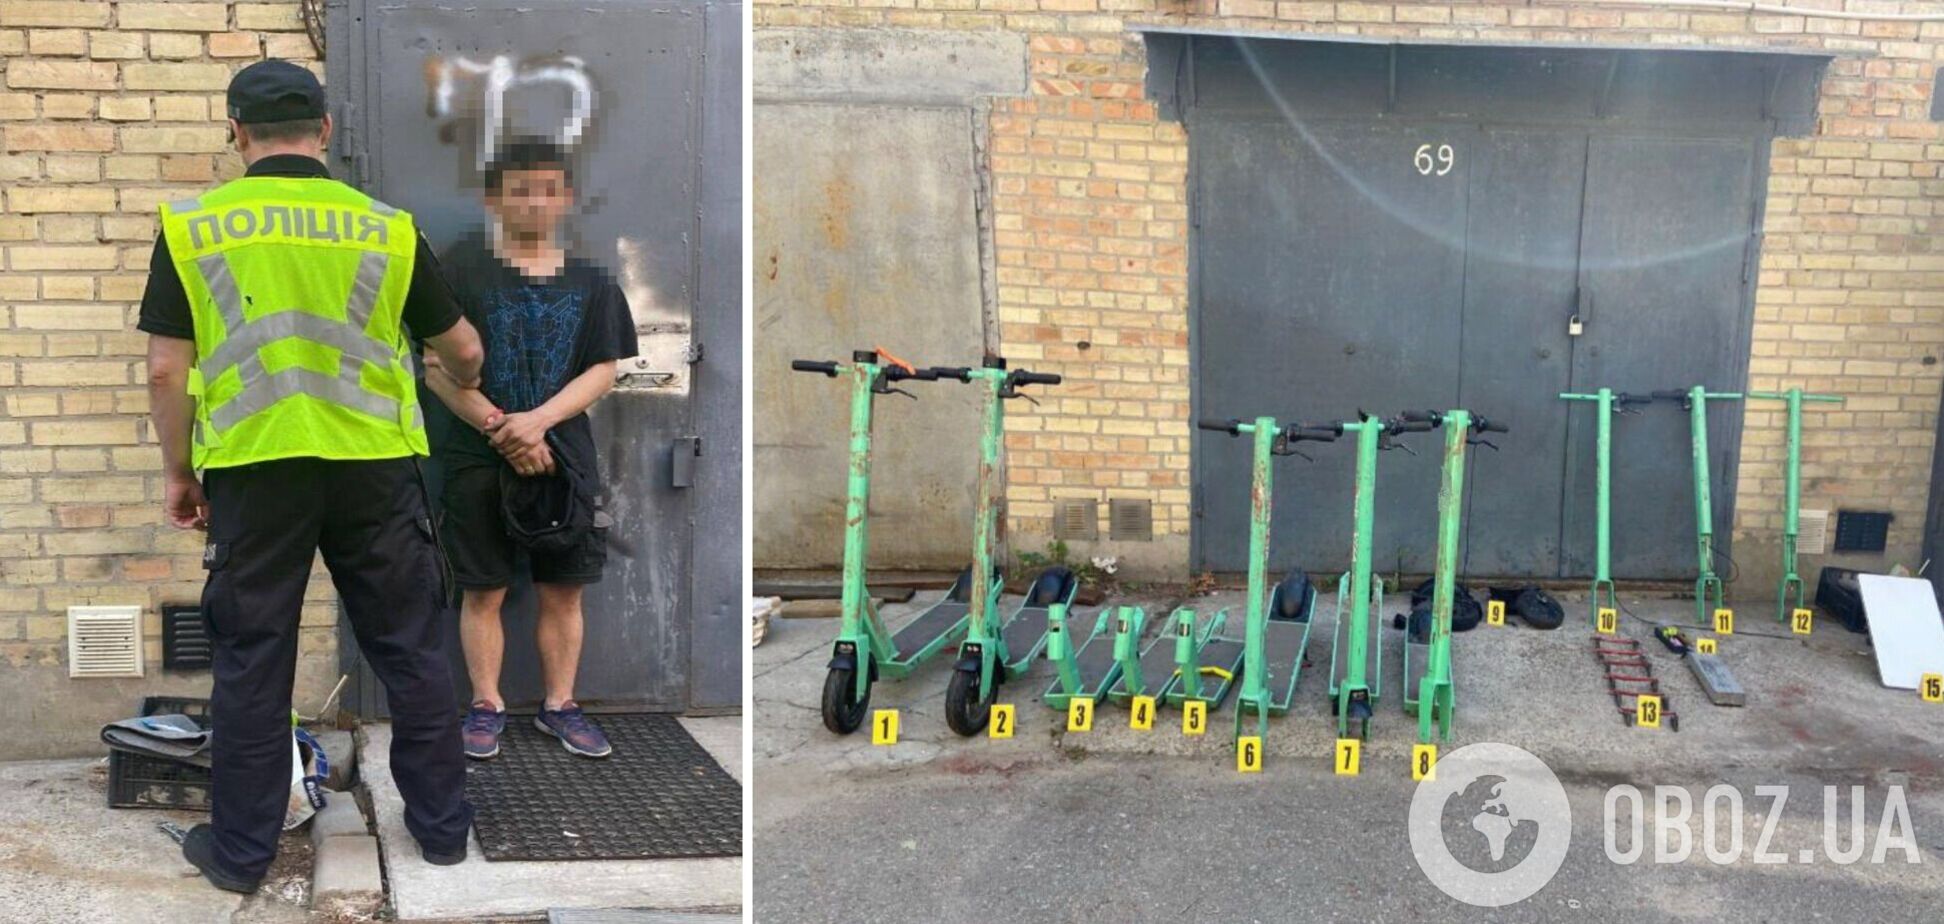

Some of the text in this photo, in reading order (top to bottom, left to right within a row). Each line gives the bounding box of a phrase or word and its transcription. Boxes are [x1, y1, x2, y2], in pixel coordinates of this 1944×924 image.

[1414, 144, 1454, 176] 69
[187, 205, 389, 250] ПОЛІЦІЯ
[1492, 605, 1500, 622] 9
[1601, 612, 1614, 630] 10
[1718, 613, 1729, 631] 11
[1796, 613, 1809, 630] 12
[1926, 678, 1940, 698] 15
[996, 710, 1007, 733] 2
[1075, 704, 1085, 727] 3
[1136, 703, 1147, 725] 4
[1189, 707, 1199, 729] 5
[1641, 700, 1657, 723] 13
[881, 715, 889, 740] 1
[1244, 742, 1254, 767] 6
[1343, 746, 1352, 770] 7
[1419, 751, 1429, 776] 8
